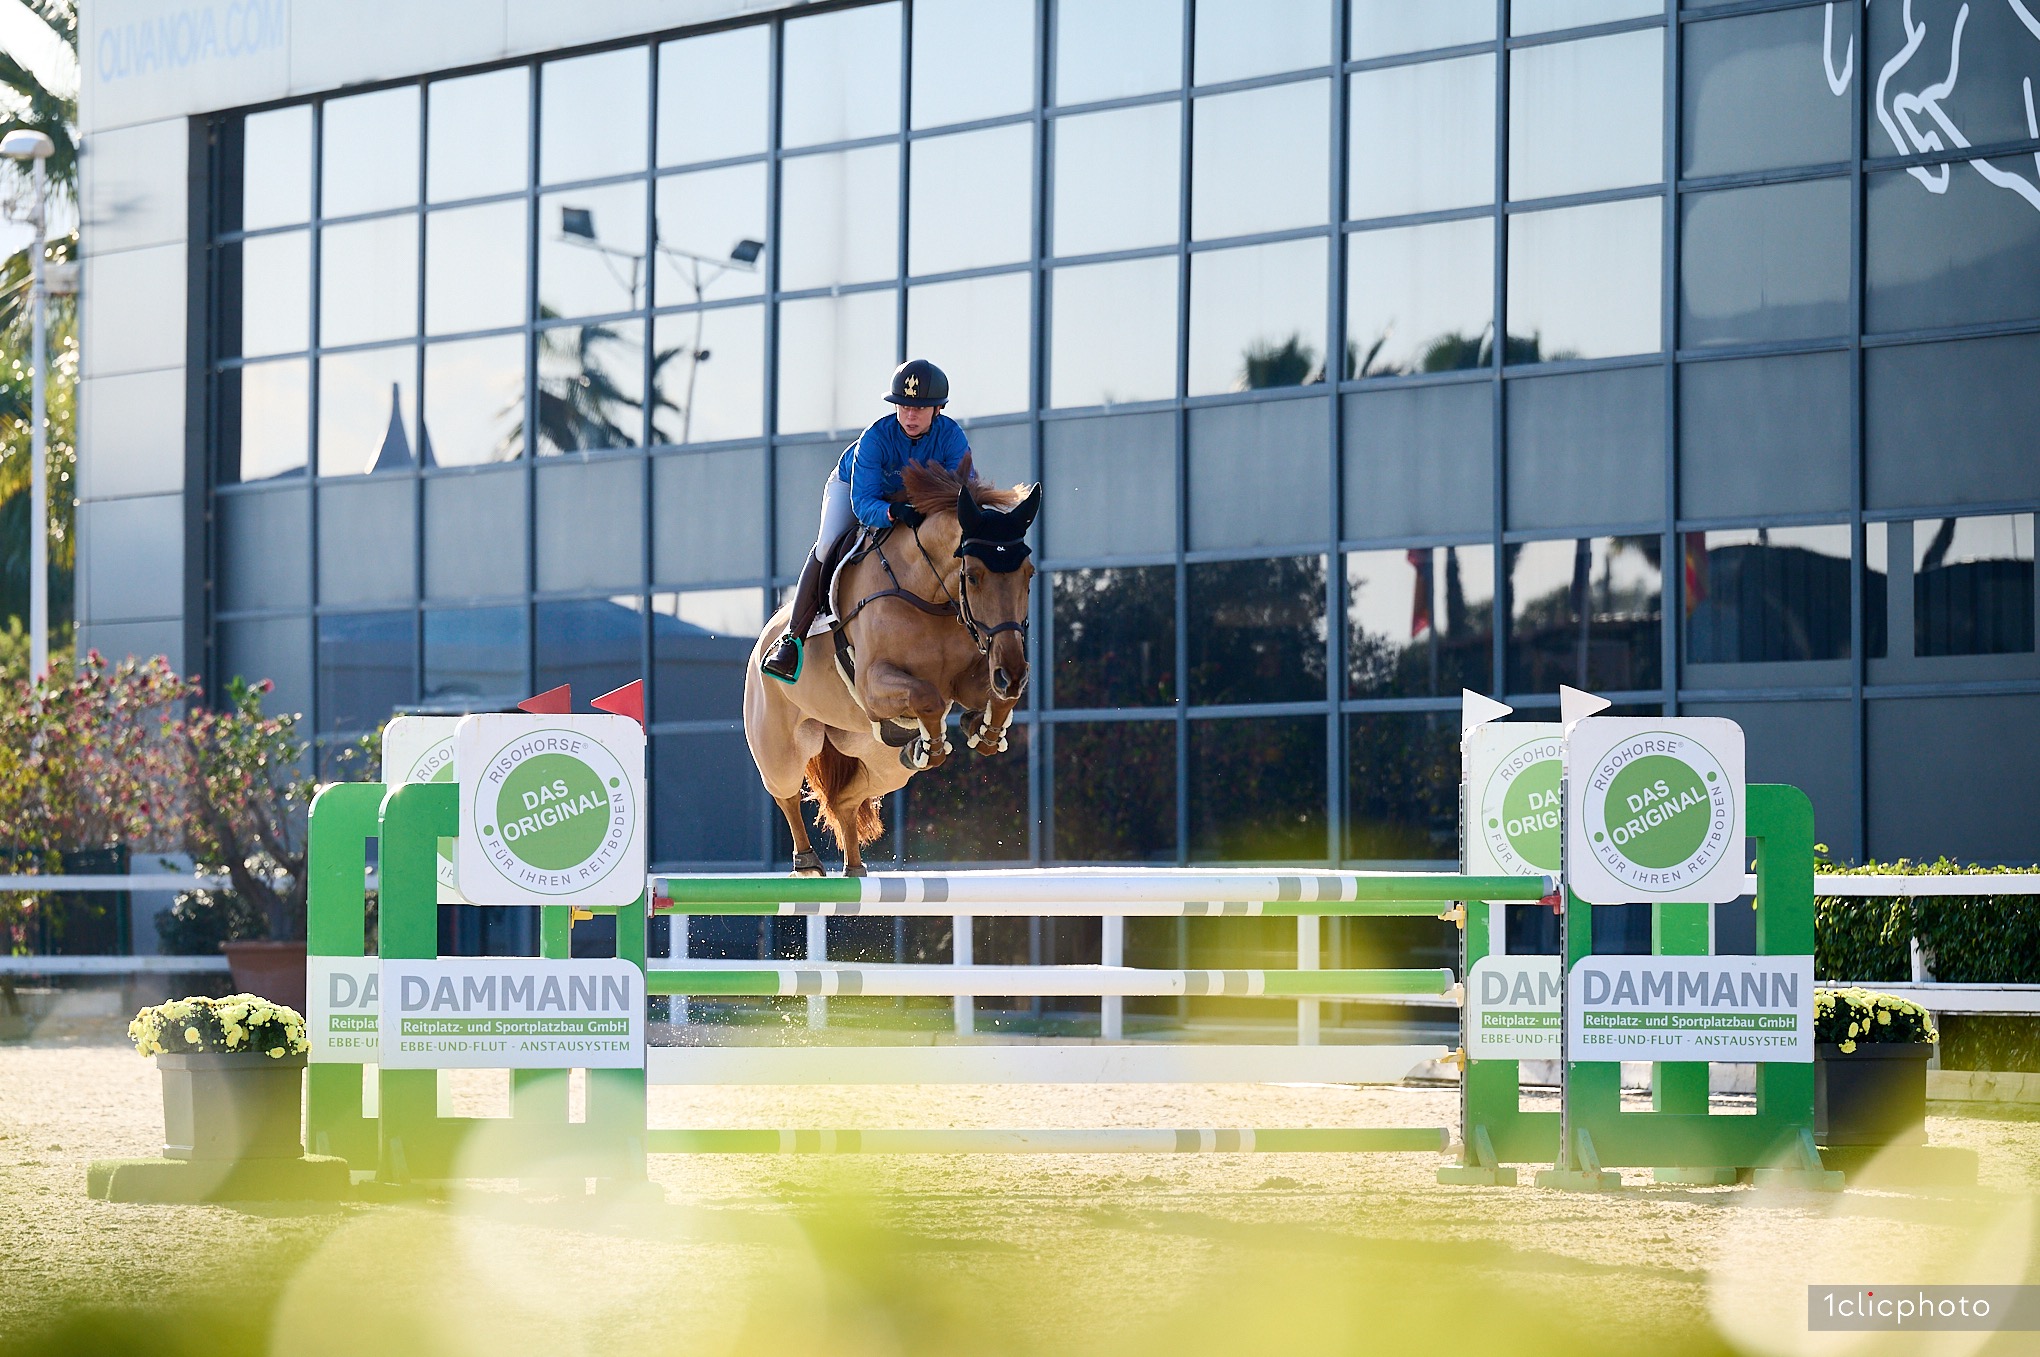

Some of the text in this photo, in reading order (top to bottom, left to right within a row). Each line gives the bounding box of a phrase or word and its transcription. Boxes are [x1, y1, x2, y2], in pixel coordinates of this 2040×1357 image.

[99, 0, 284, 83] OLIVANOVA.COM
[416, 744, 454, 783] RISO
[521, 779, 569, 811] DAS
[1626, 779, 1670, 813] DAS
[503, 790, 607, 843] ORIGINAL
[1612, 786, 1707, 845] ORIGINAL
[488, 793, 625, 886] FÜR IHREN REITBODEN
[1491, 833, 1513, 863] FÜR
[1600, 785, 1726, 884] FÜR IHREN REITBODEN
[401, 975, 630, 1011] DAMMANN
[1583, 970, 1798, 1008] DAMMANN
[403, 1021, 627, 1035] Reitplatz- und Sportplatzbau GmbH
[1484, 1014, 1539, 1028] Reitplatz-
[1585, 1014, 1795, 1029] Reitplatz- und Sportplatzbau GmbH
[400, 1041, 507, 1051] EBBE-UND-FLUT
[520, 1041, 630, 1051] ANSTAUSYSTEM
[1583, 1034, 1683, 1045] EBBE-UND-FLUT
[1694, 1035, 1797, 1047] ANSTAUSYSTEM
